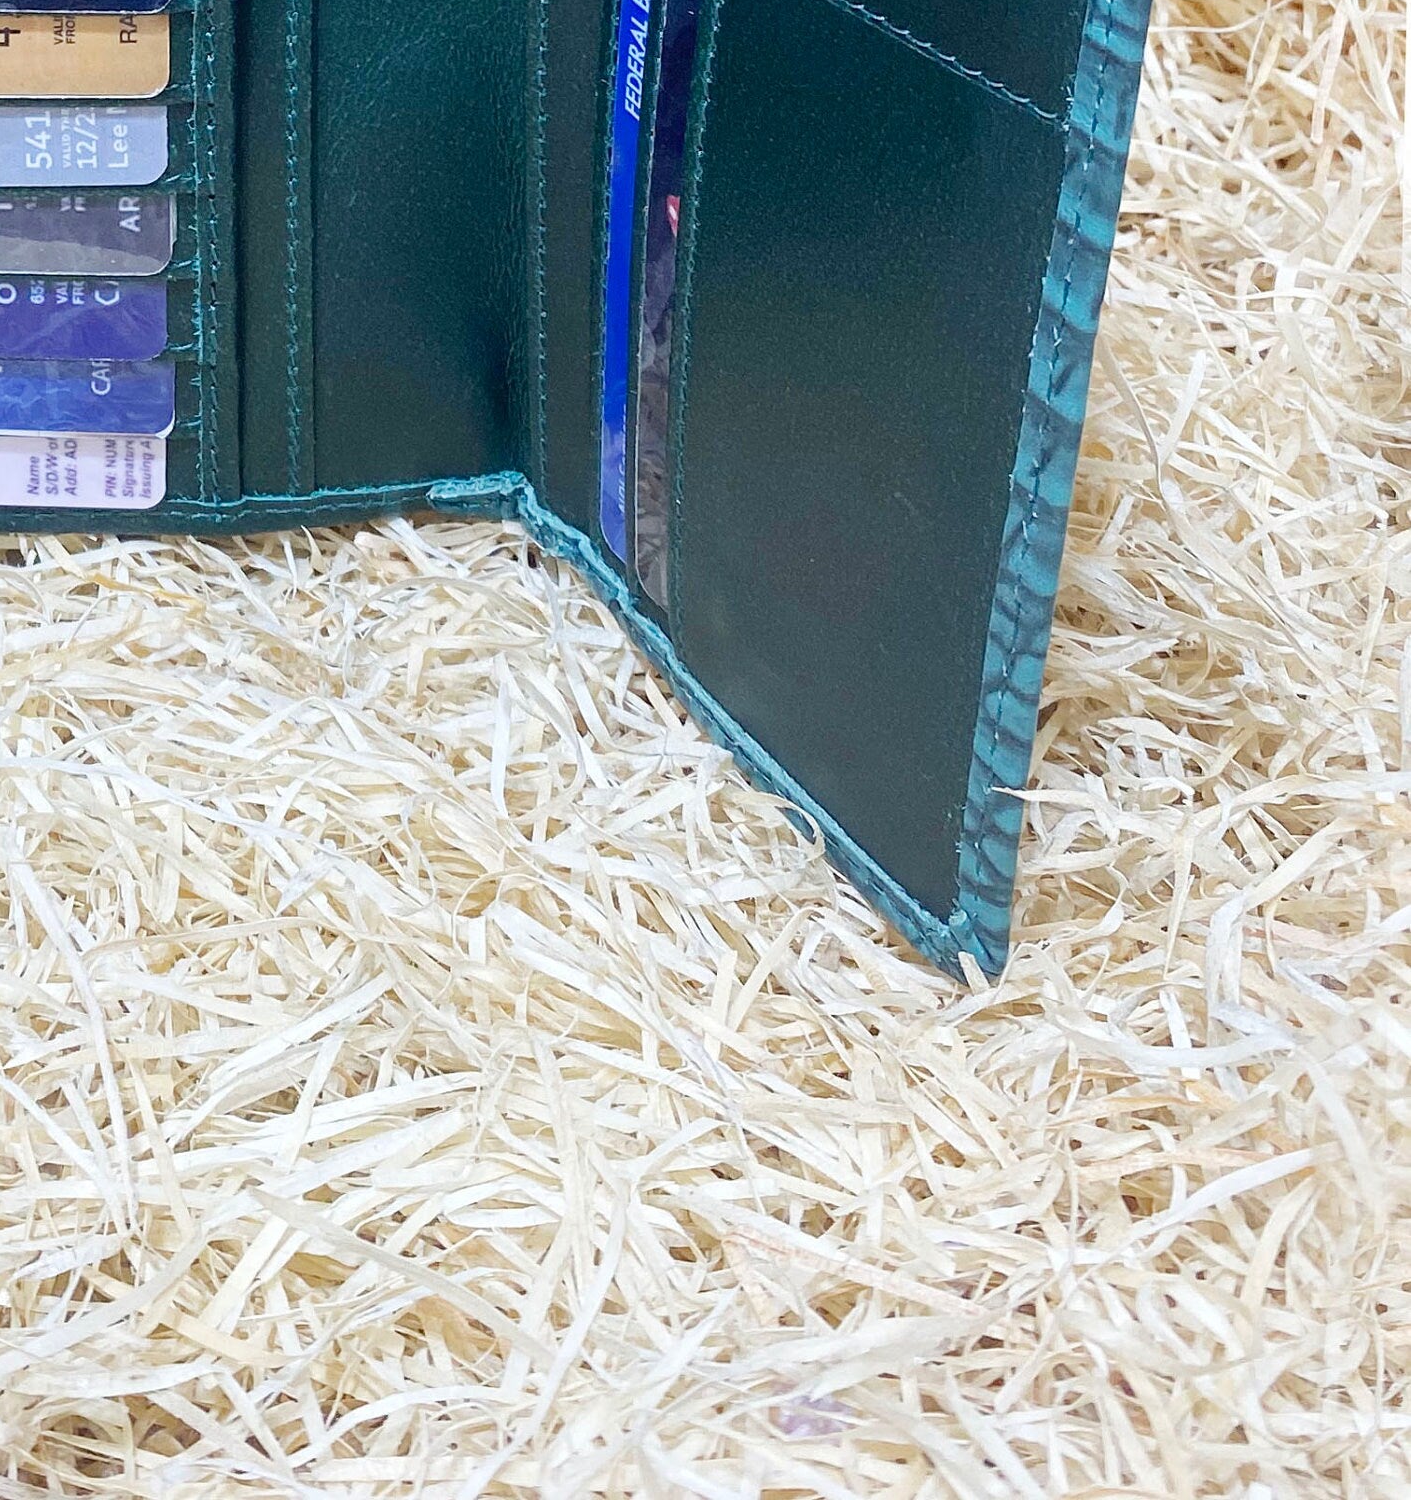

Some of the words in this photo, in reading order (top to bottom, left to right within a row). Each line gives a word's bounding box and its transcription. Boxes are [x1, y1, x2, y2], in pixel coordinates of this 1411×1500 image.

[624, 20, 649, 122] FEDERAL
[24, 110, 53, 170] 541
[62, 134, 72, 169] VALID
[73, 107, 99, 169] 12/2
[107, 123, 129, 169] Lee
[27, 456, 40, 496] Name
[139, 452, 155, 499] Issuing
